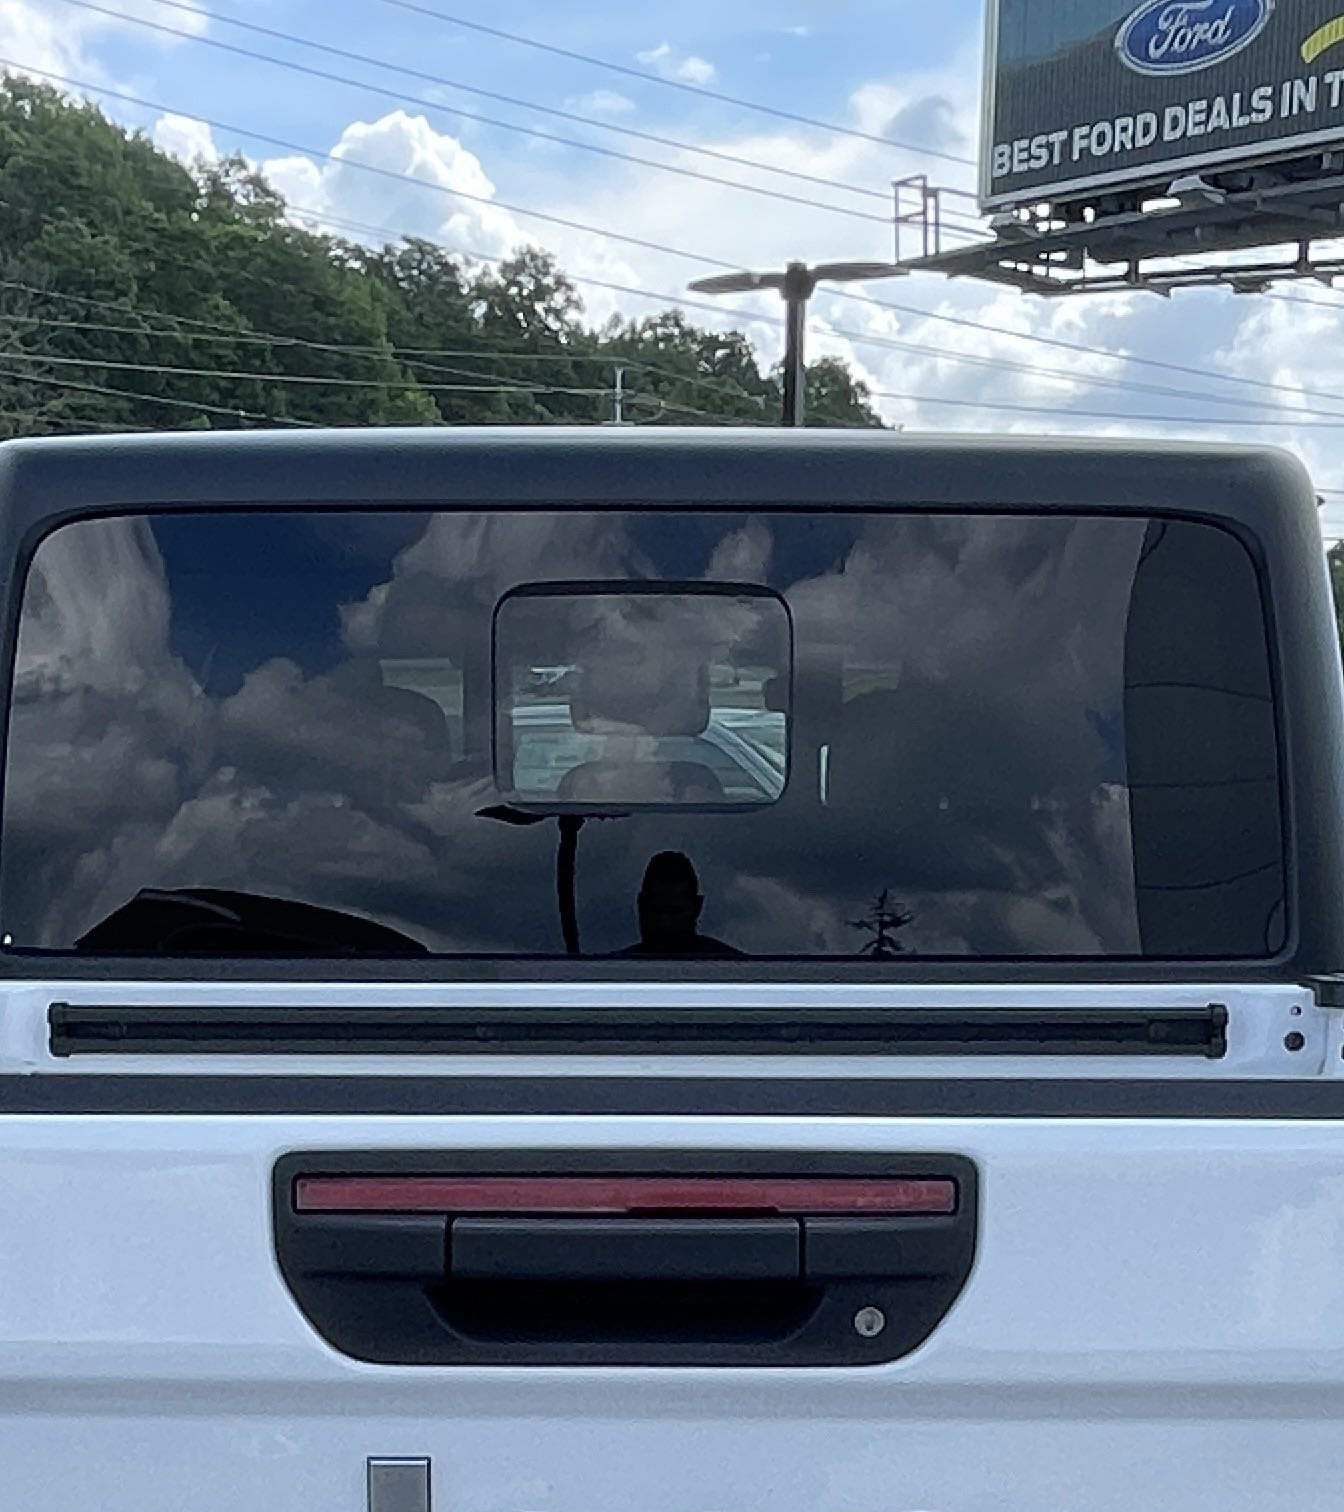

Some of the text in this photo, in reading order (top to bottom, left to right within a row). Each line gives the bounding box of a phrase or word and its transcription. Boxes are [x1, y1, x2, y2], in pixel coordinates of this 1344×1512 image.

[1148, 0, 1235, 60] Ford
[992, 130, 1070, 179] BEST
[1072, 112, 1158, 163] FORD
[1163, 86, 1273, 142] DEALS
[1280, 75, 1319, 119] IN
